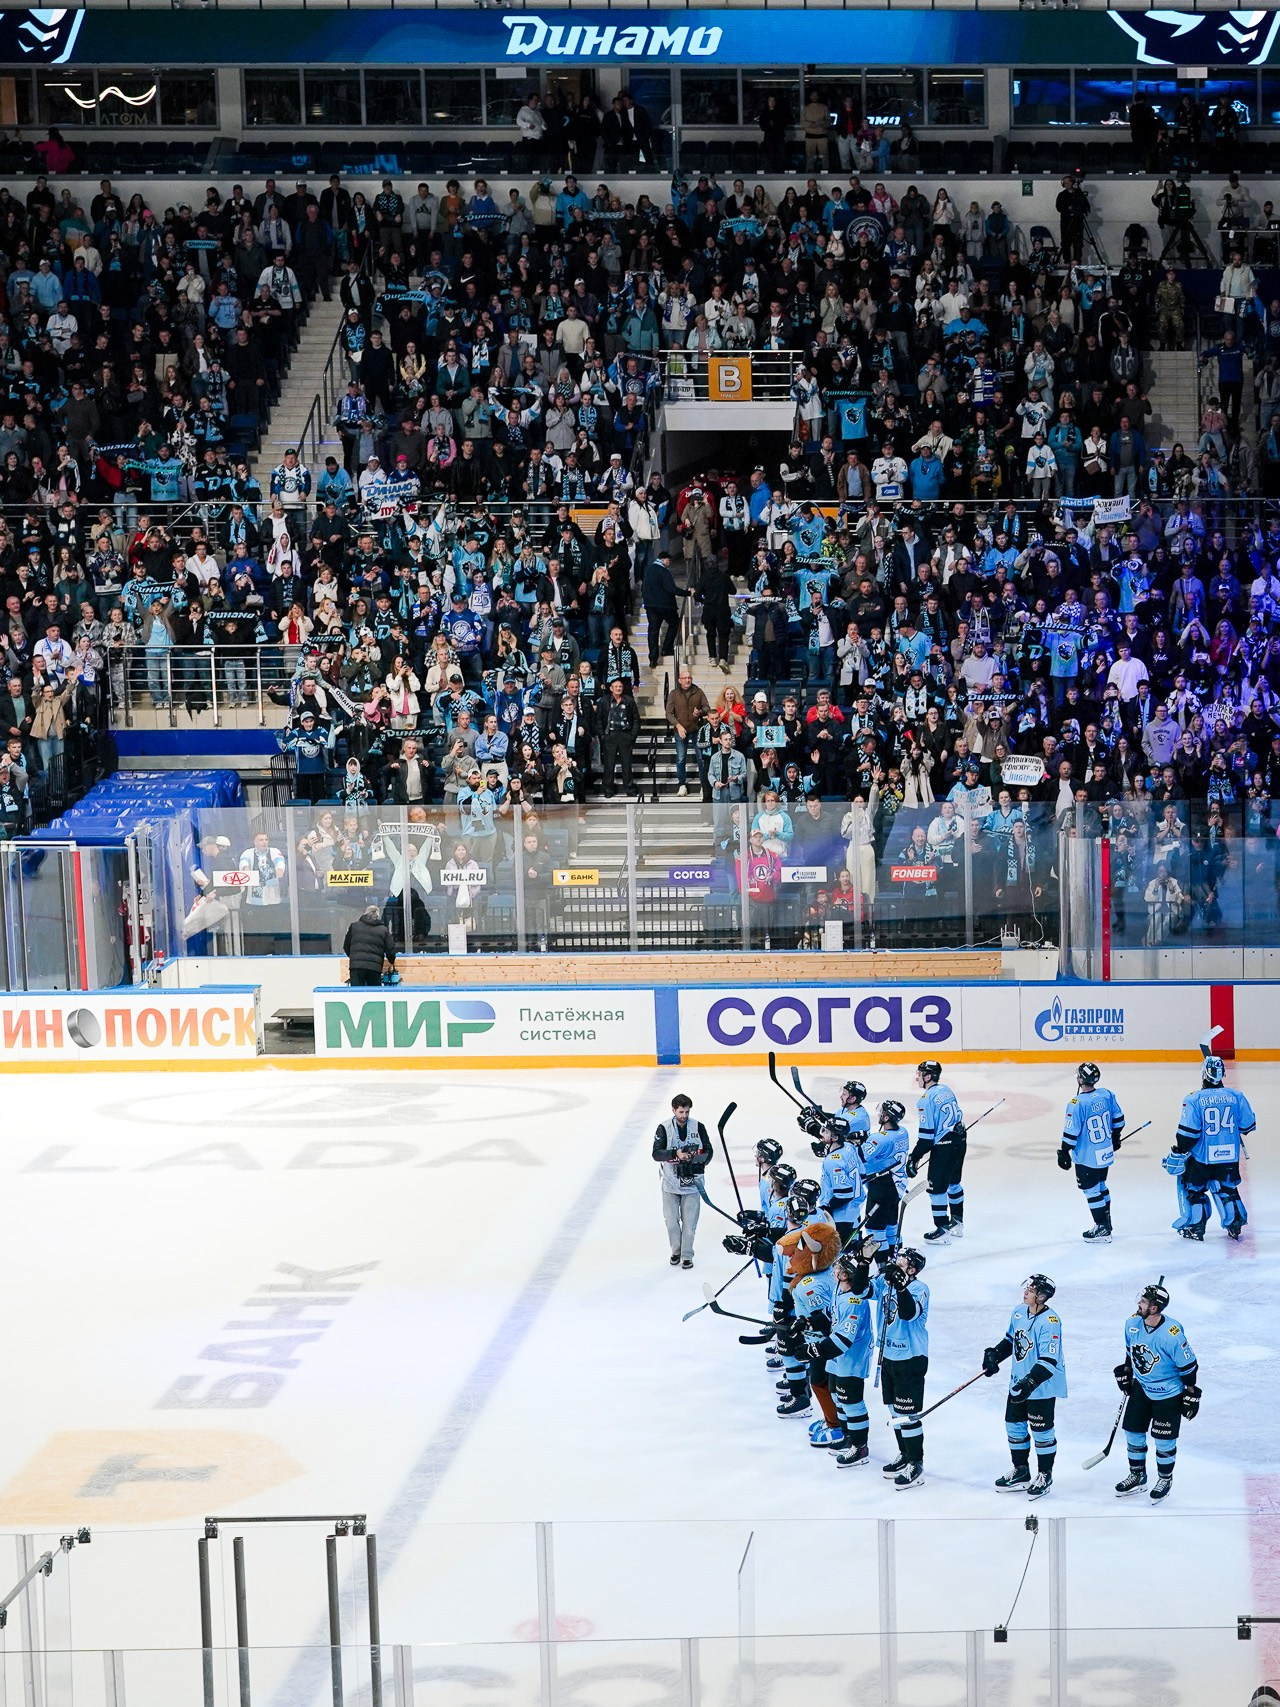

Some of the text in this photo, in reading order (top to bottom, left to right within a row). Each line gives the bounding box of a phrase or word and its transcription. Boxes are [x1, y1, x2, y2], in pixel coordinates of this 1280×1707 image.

[501, 16, 724, 56] Динамо
[385, 727, 436, 738] Динамо
[443, 872, 484, 882] KHL.RU
[674, 870, 710, 879] согаз
[893, 868, 935, 878] FONBET
[519, 1007, 625, 1021] Платёжная
[706, 995, 953, 1046] согаз
[1064, 1008, 1125, 1025] ГАЗПРОМ
[325, 1000, 497, 1049] МИР
[1065, 1025, 1125, 1034] ТРАНСГАЗ
[519, 1030, 598, 1042] система
[1064, 1035, 1126, 1043] БЕЛАРУСЬ
[1086, 1110, 1112, 1144] 80
[1203, 1107, 1235, 1136] 94
[18, 1138, 547, 1174] LADA
[809, 1296, 824, 1307] 48
[844, 1321, 858, 1335] 93
[151, 1260, 382, 1411] БАНК
